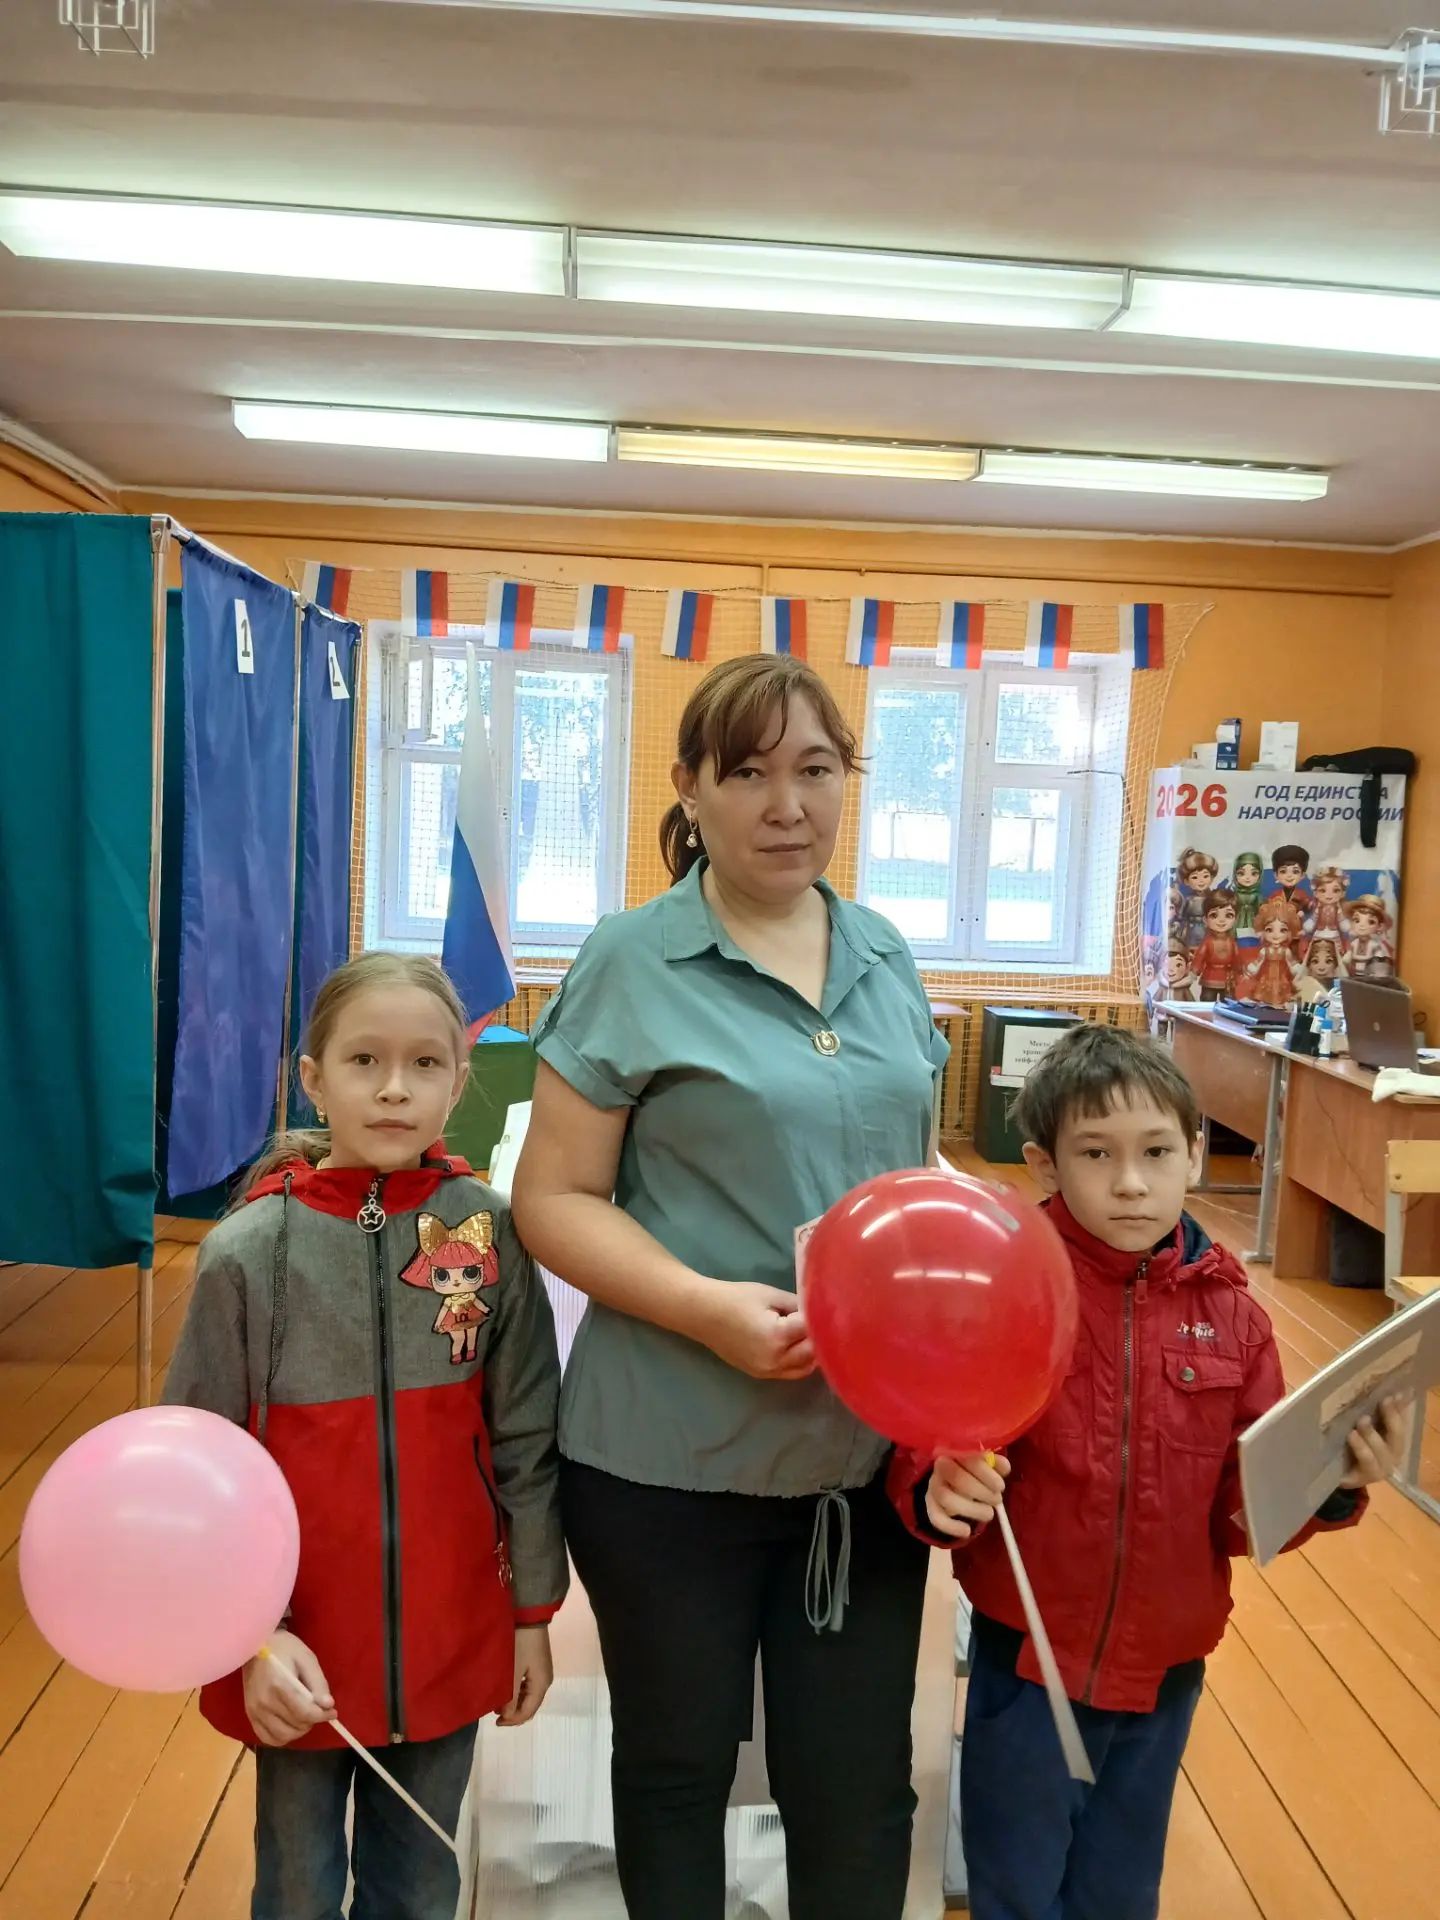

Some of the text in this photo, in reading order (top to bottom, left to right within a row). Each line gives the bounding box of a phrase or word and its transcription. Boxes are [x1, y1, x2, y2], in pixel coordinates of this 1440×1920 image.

[241, 619, 251, 658] 1
[1156, 783, 1228, 818] 2026
[1254, 785, 1389, 802] ГОД ЕДИНСТА
[1237, 805, 1405, 823] НАРОДОВ РОСИИ
